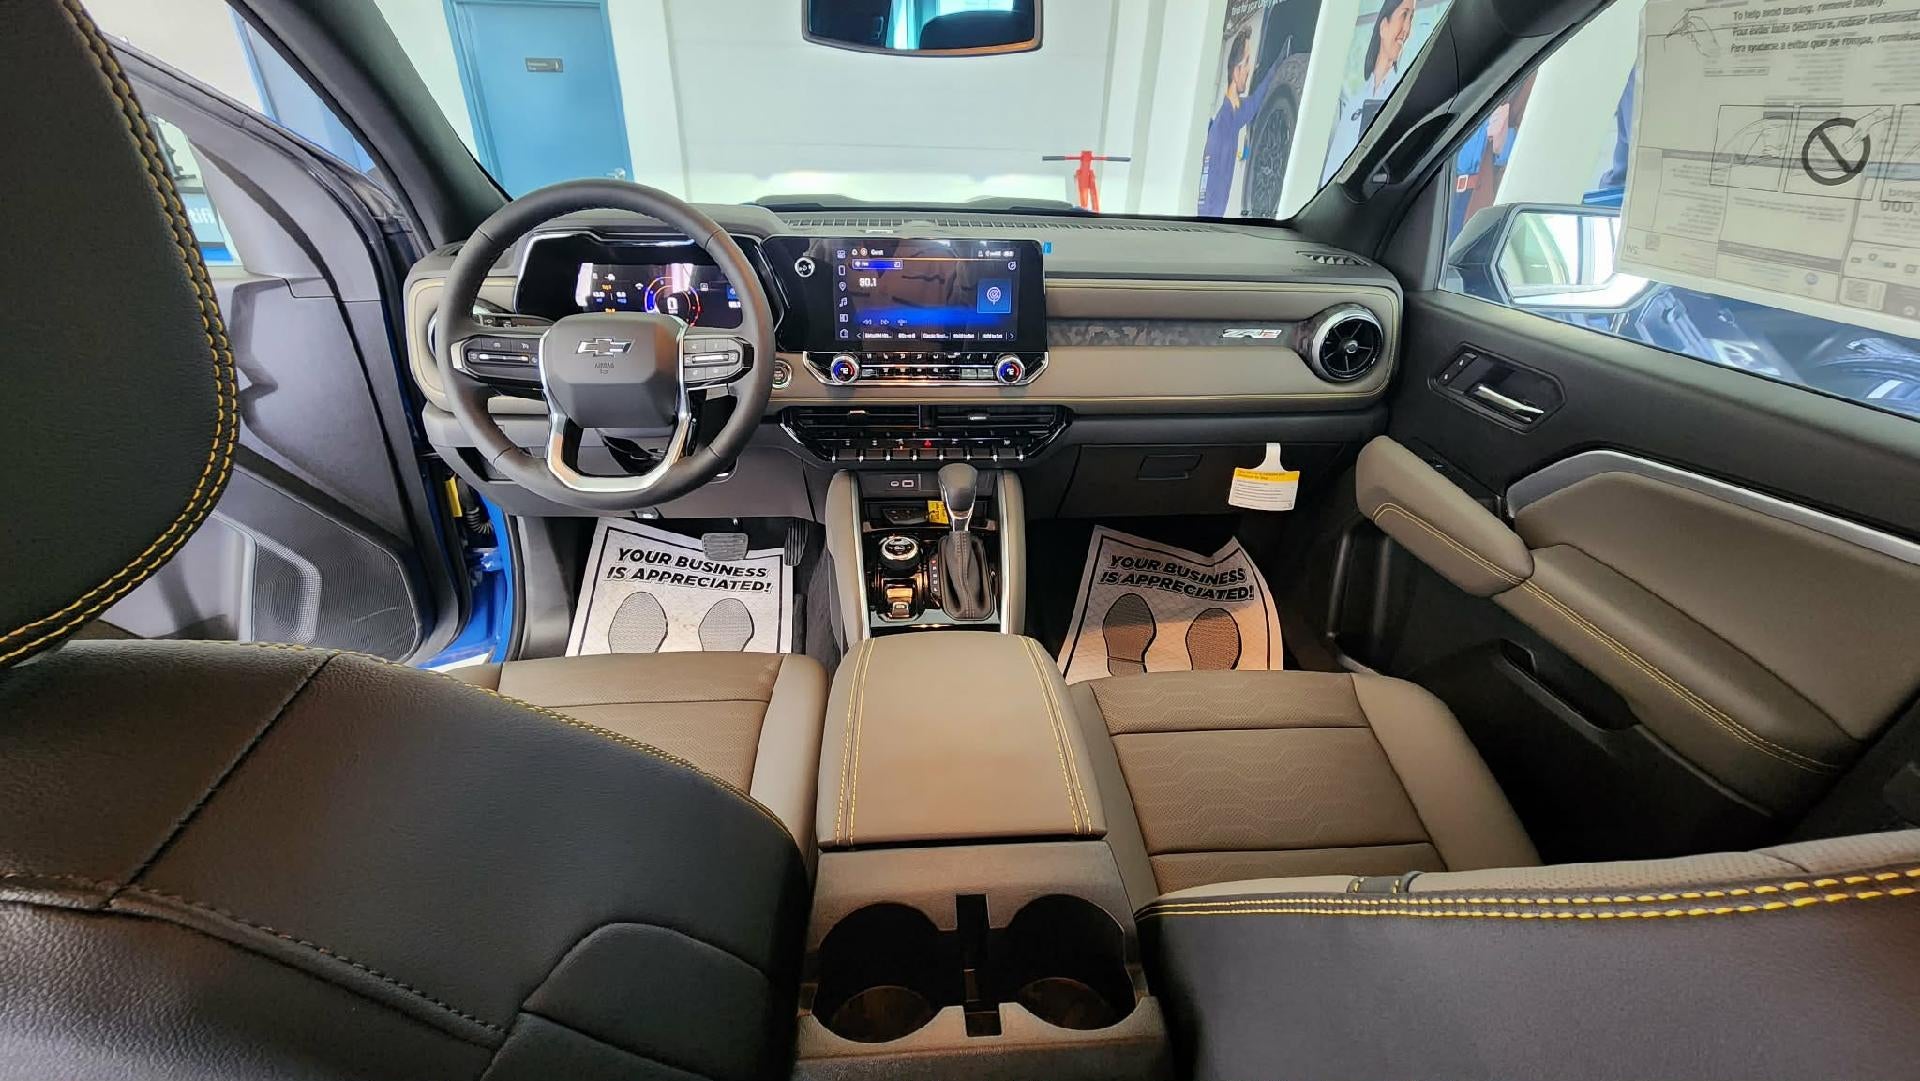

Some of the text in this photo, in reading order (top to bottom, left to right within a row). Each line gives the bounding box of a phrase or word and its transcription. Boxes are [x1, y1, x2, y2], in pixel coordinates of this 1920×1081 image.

[618, 547, 768, 578] YOUR BUSINESS
[1109, 554, 1248, 586] YOUR BUSINESS
[606, 566, 773, 593] IS APPRECIATED!
[1100, 571, 1255, 601] IS APPRECIATED!
